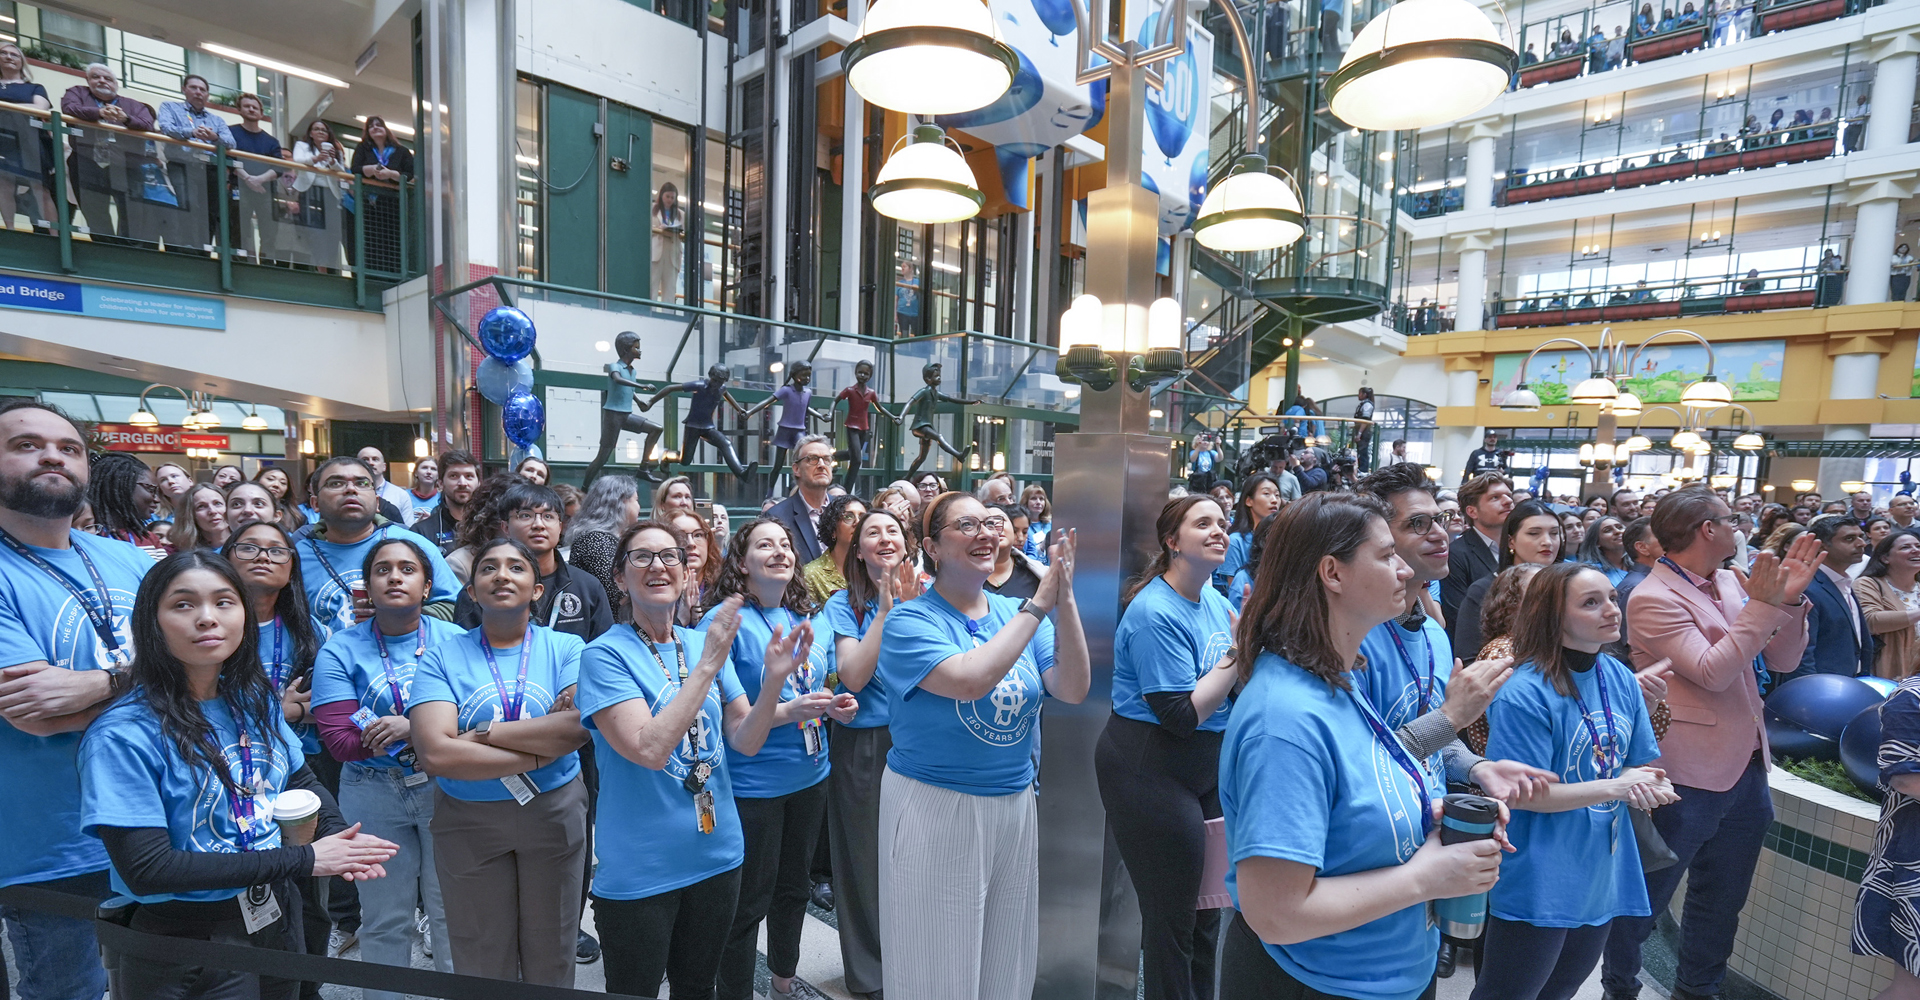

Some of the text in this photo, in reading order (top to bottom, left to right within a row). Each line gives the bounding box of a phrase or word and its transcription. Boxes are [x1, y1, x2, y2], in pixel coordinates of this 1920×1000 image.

[20, 286, 65, 301] Bridge
[99, 304, 133, 312] children's
[101, 296, 142, 306] Celebrating
[185, 305, 213, 314] inspiring
[94, 432, 174, 445] MERGENC
[182, 438, 220, 446] Emergency
[62, 628, 72, 644] THE
[636, 629, 652, 646] SickKids
[462, 709, 470, 720] THE
[1392, 711, 1402, 724] THE
[966, 716, 982, 730] 150
[984, 729, 1013, 742] YEARS
[1573, 746, 1581, 757] THE
[1384, 774, 1392, 794] THE
[204, 793, 214, 808] THE
[206, 839, 230, 854] 150
